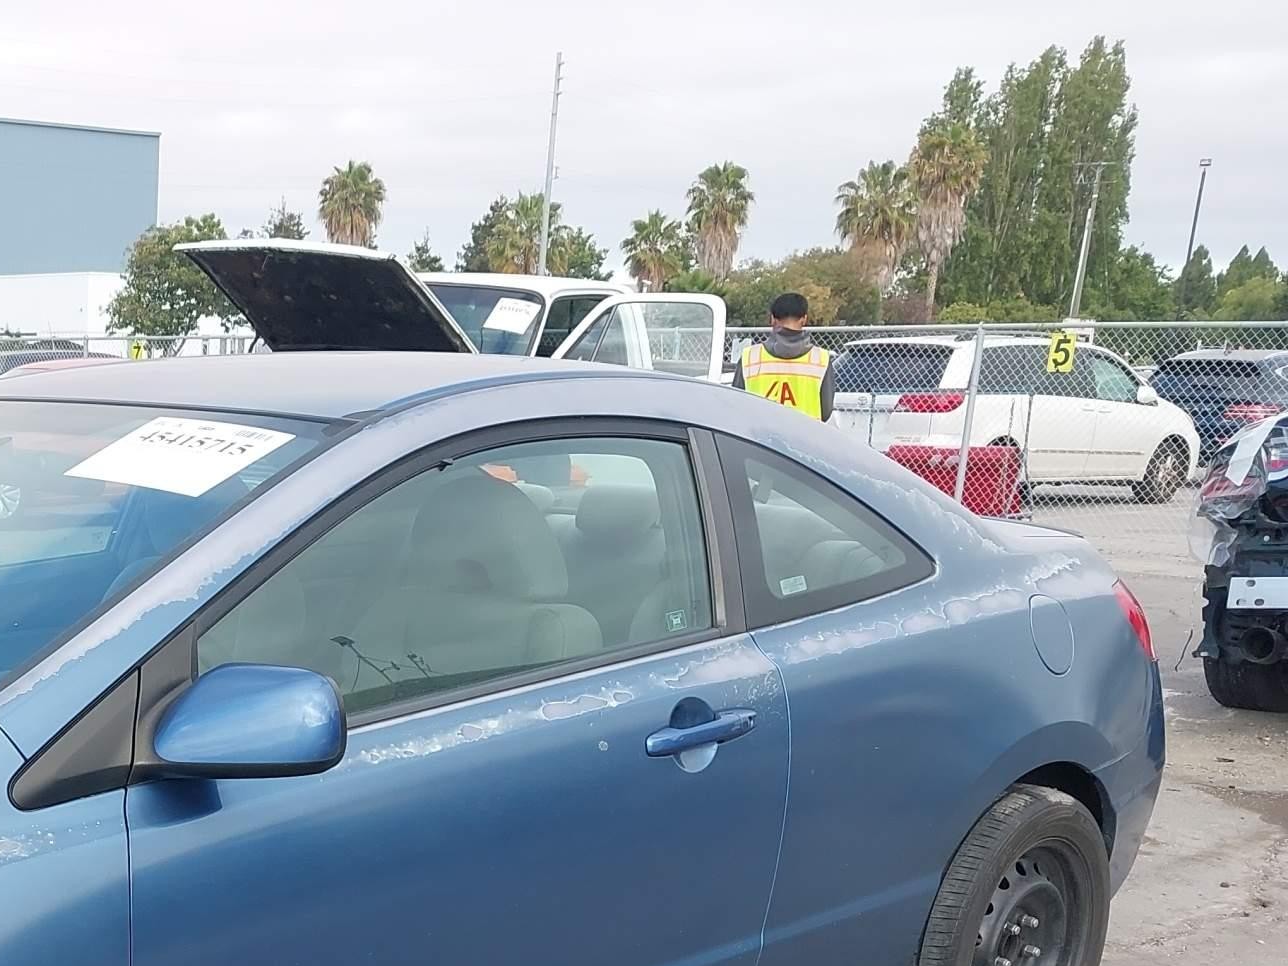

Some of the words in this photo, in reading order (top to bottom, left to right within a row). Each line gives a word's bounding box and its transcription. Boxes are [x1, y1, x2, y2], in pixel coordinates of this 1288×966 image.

[132, 345, 142, 360] 7
[1052, 338, 1072, 368] 5
[139, 430, 255, 456] 45415715
